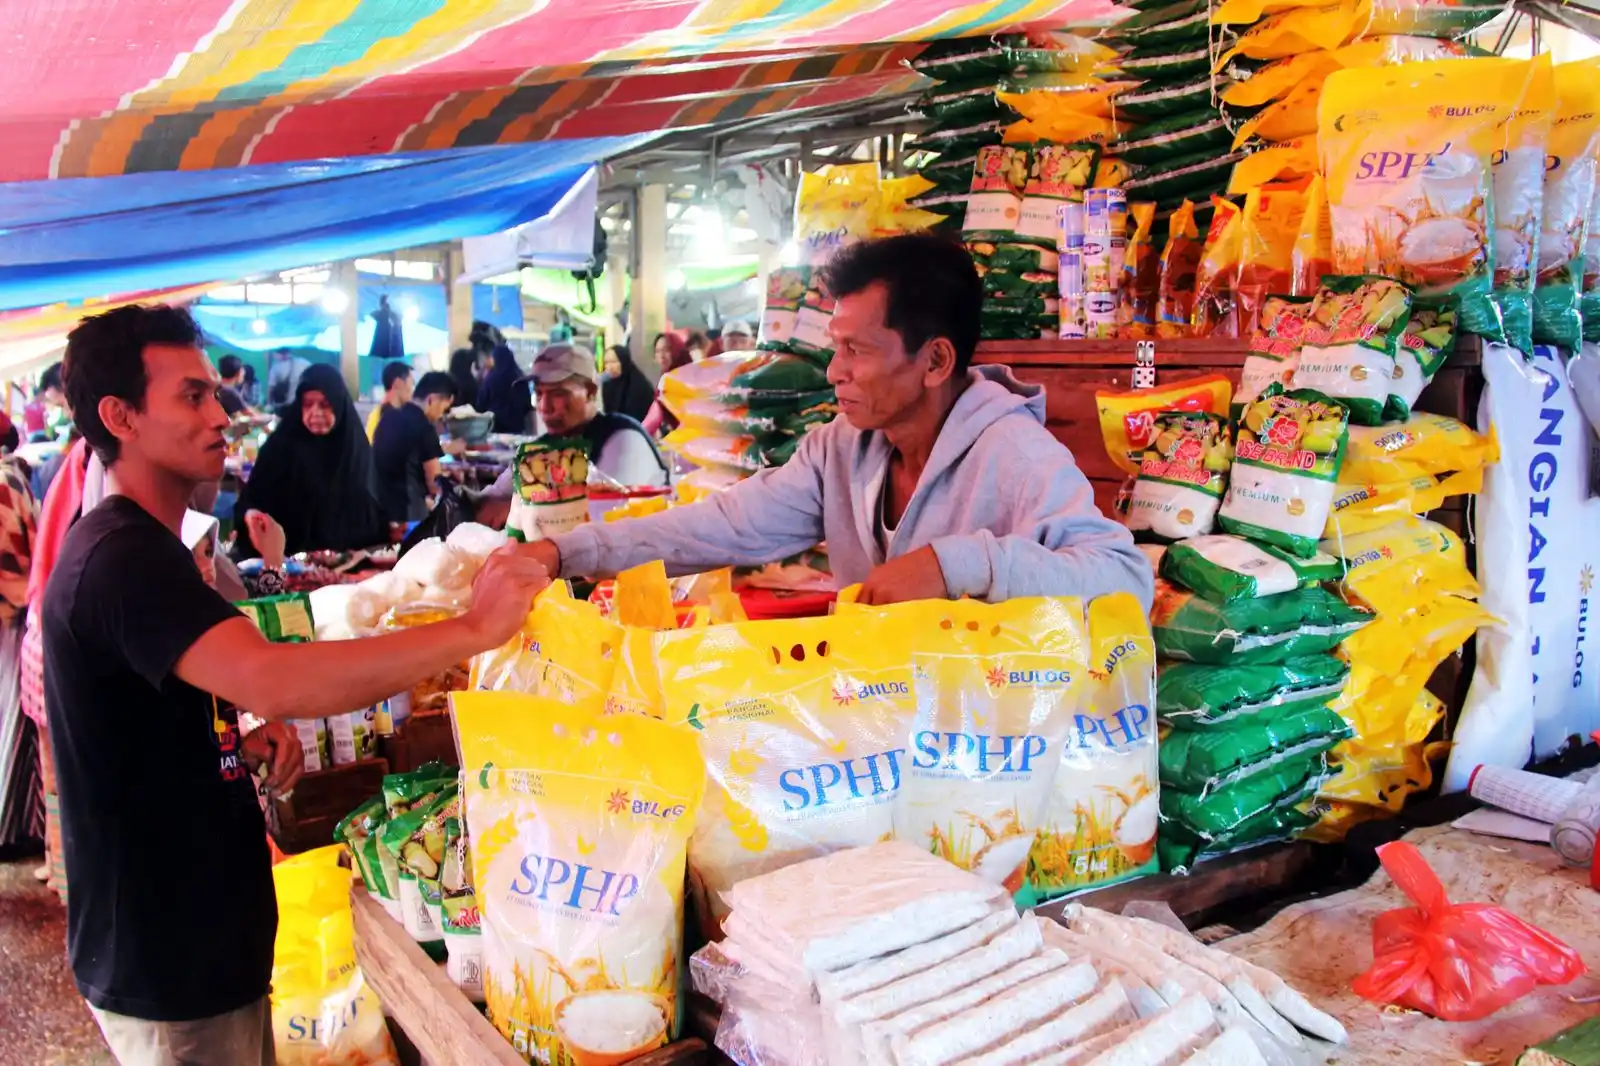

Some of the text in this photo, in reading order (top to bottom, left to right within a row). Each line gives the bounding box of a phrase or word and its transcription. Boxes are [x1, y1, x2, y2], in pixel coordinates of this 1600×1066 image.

[1355, 142, 1452, 180] SPH
[1262, 447, 1317, 472] BRND
[1573, 598, 1589, 689] BULOG
[1009, 670, 1071, 684] BULOG
[1065, 704, 1149, 750] PHP
[912, 730, 1047, 772] SPHP
[510, 853, 640, 916] SPHP
[1074, 855, 1089, 875] 5
